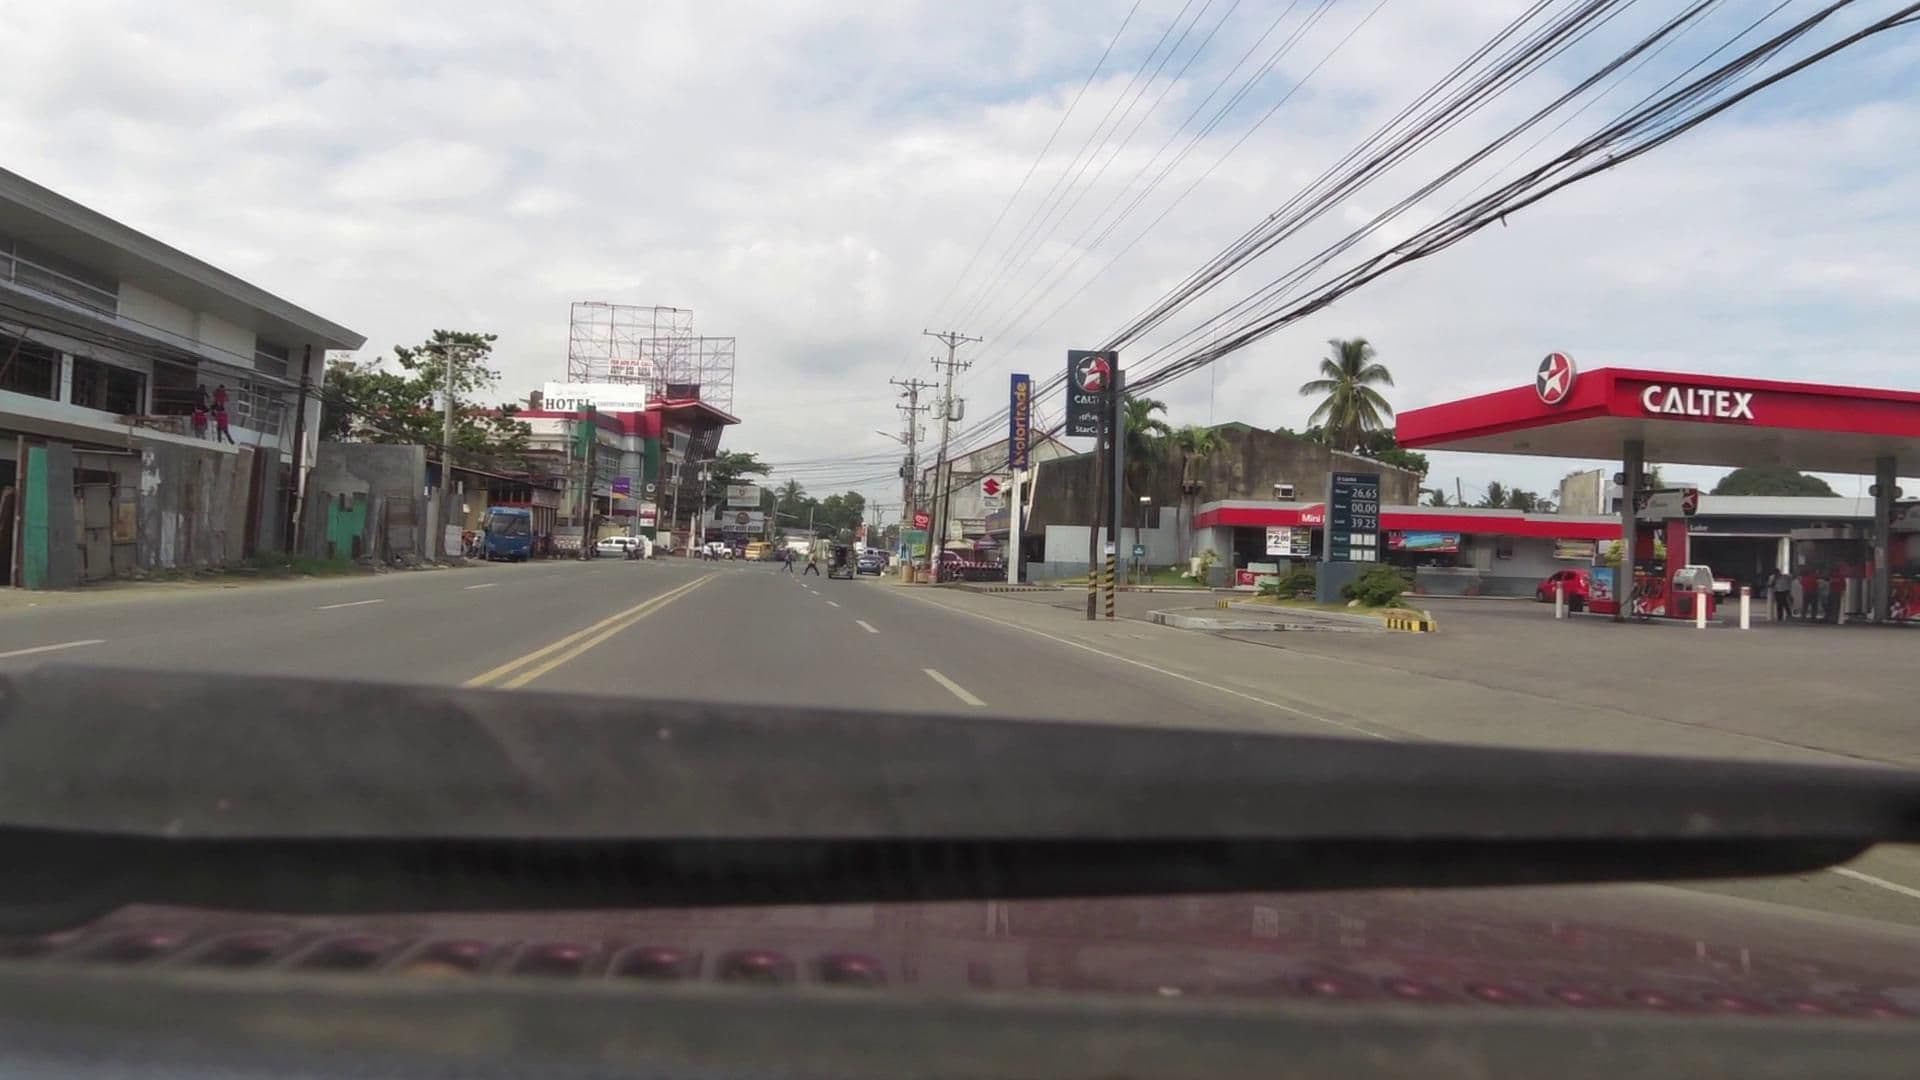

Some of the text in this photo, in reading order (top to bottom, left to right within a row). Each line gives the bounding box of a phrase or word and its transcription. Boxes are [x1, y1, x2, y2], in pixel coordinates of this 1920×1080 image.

[1643, 385, 1754, 419] CALTEX
[1351, 488, 1377, 498] 26.65
[1351, 503, 1377, 513] 00.00
[1301, 513, 1321, 523] Mini
[1350, 519, 1376, 529] 39.25
